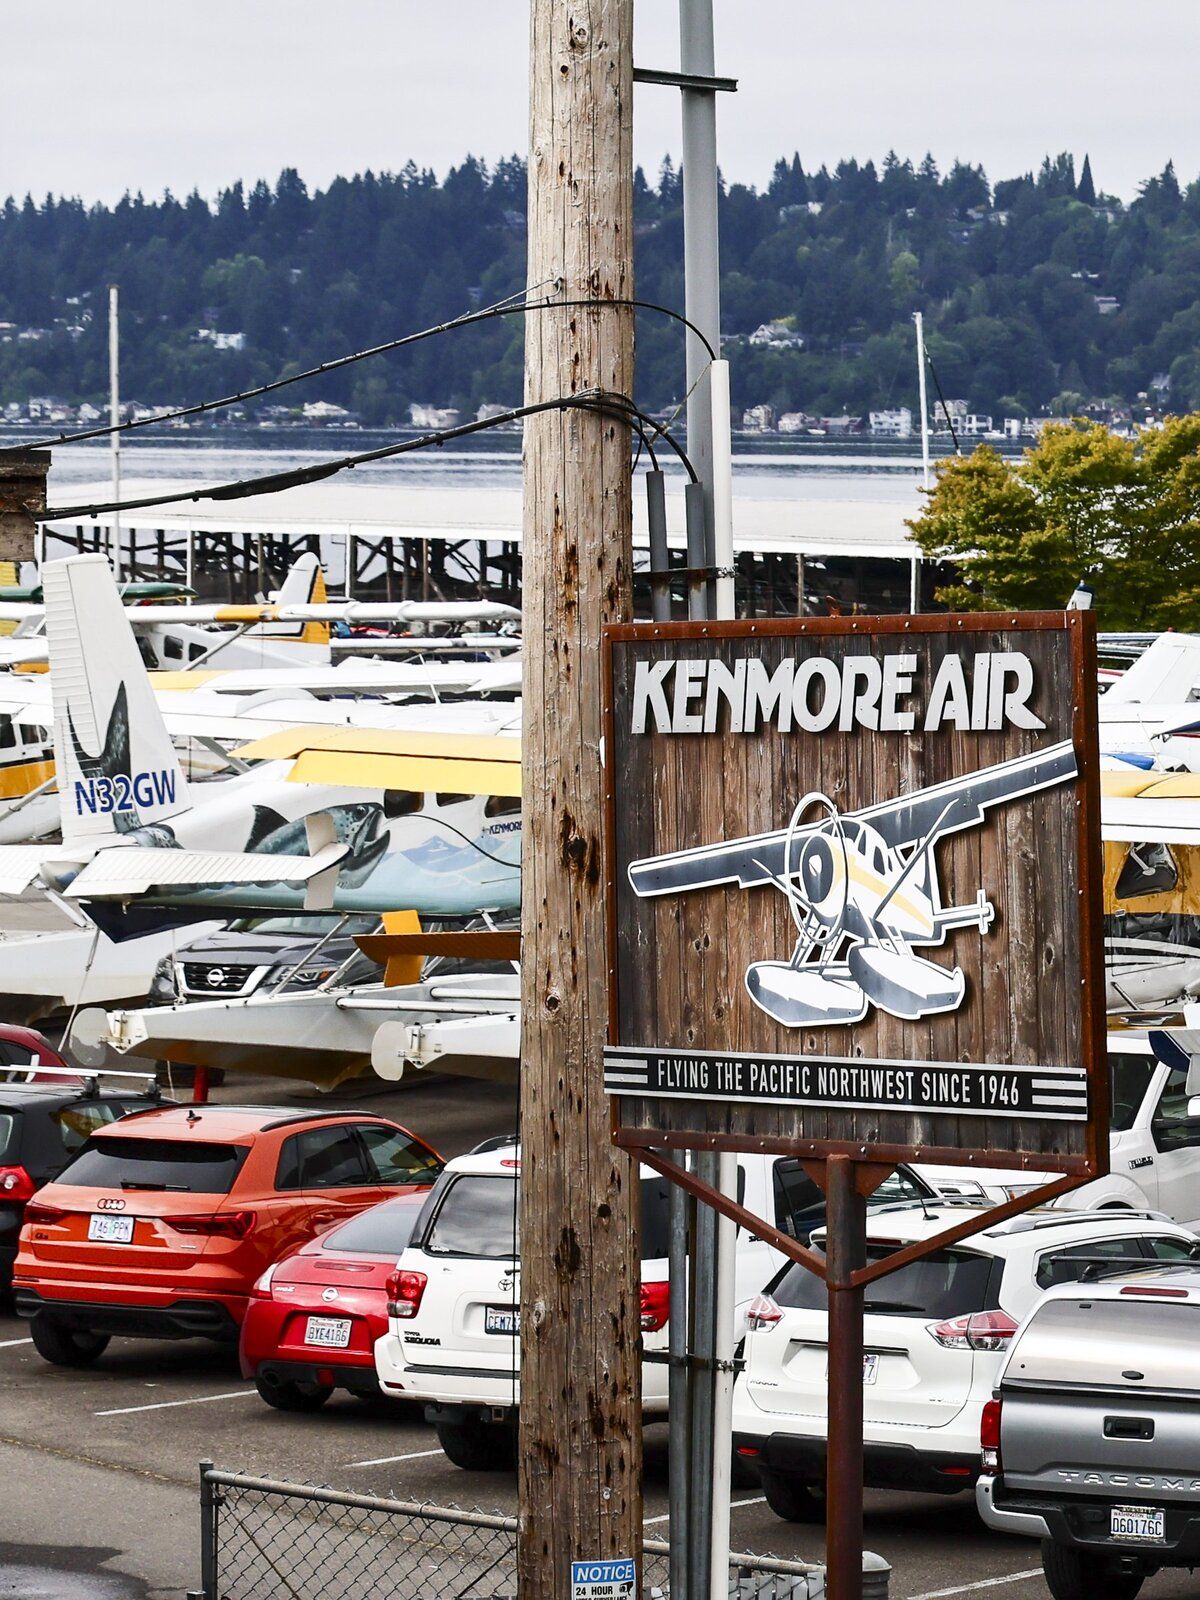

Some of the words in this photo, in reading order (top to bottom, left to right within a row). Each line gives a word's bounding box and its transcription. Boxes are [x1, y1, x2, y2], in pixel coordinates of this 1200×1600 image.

[631, 654, 917, 734] KENMORE
[924, 652, 1046, 732] AIR
[75, 769, 176, 816] N32GW
[657, 1059, 709, 1089] FLYING
[716, 1062, 743, 1091] THE
[750, 1064, 811, 1094] PACIFIC
[817, 1067, 914, 1100] NORTHWEST
[922, 1074, 970, 1103] SINCE
[979, 1075, 1019, 1105] 1946
[488, 1315, 521, 1331] CEM7
[404, 1337, 441, 1346] SEQUOIA
[576, 1564, 632, 1581] NOTICE
[576, 1586, 587, 1596] 24
[591, 1585, 613, 1596] HOUR
